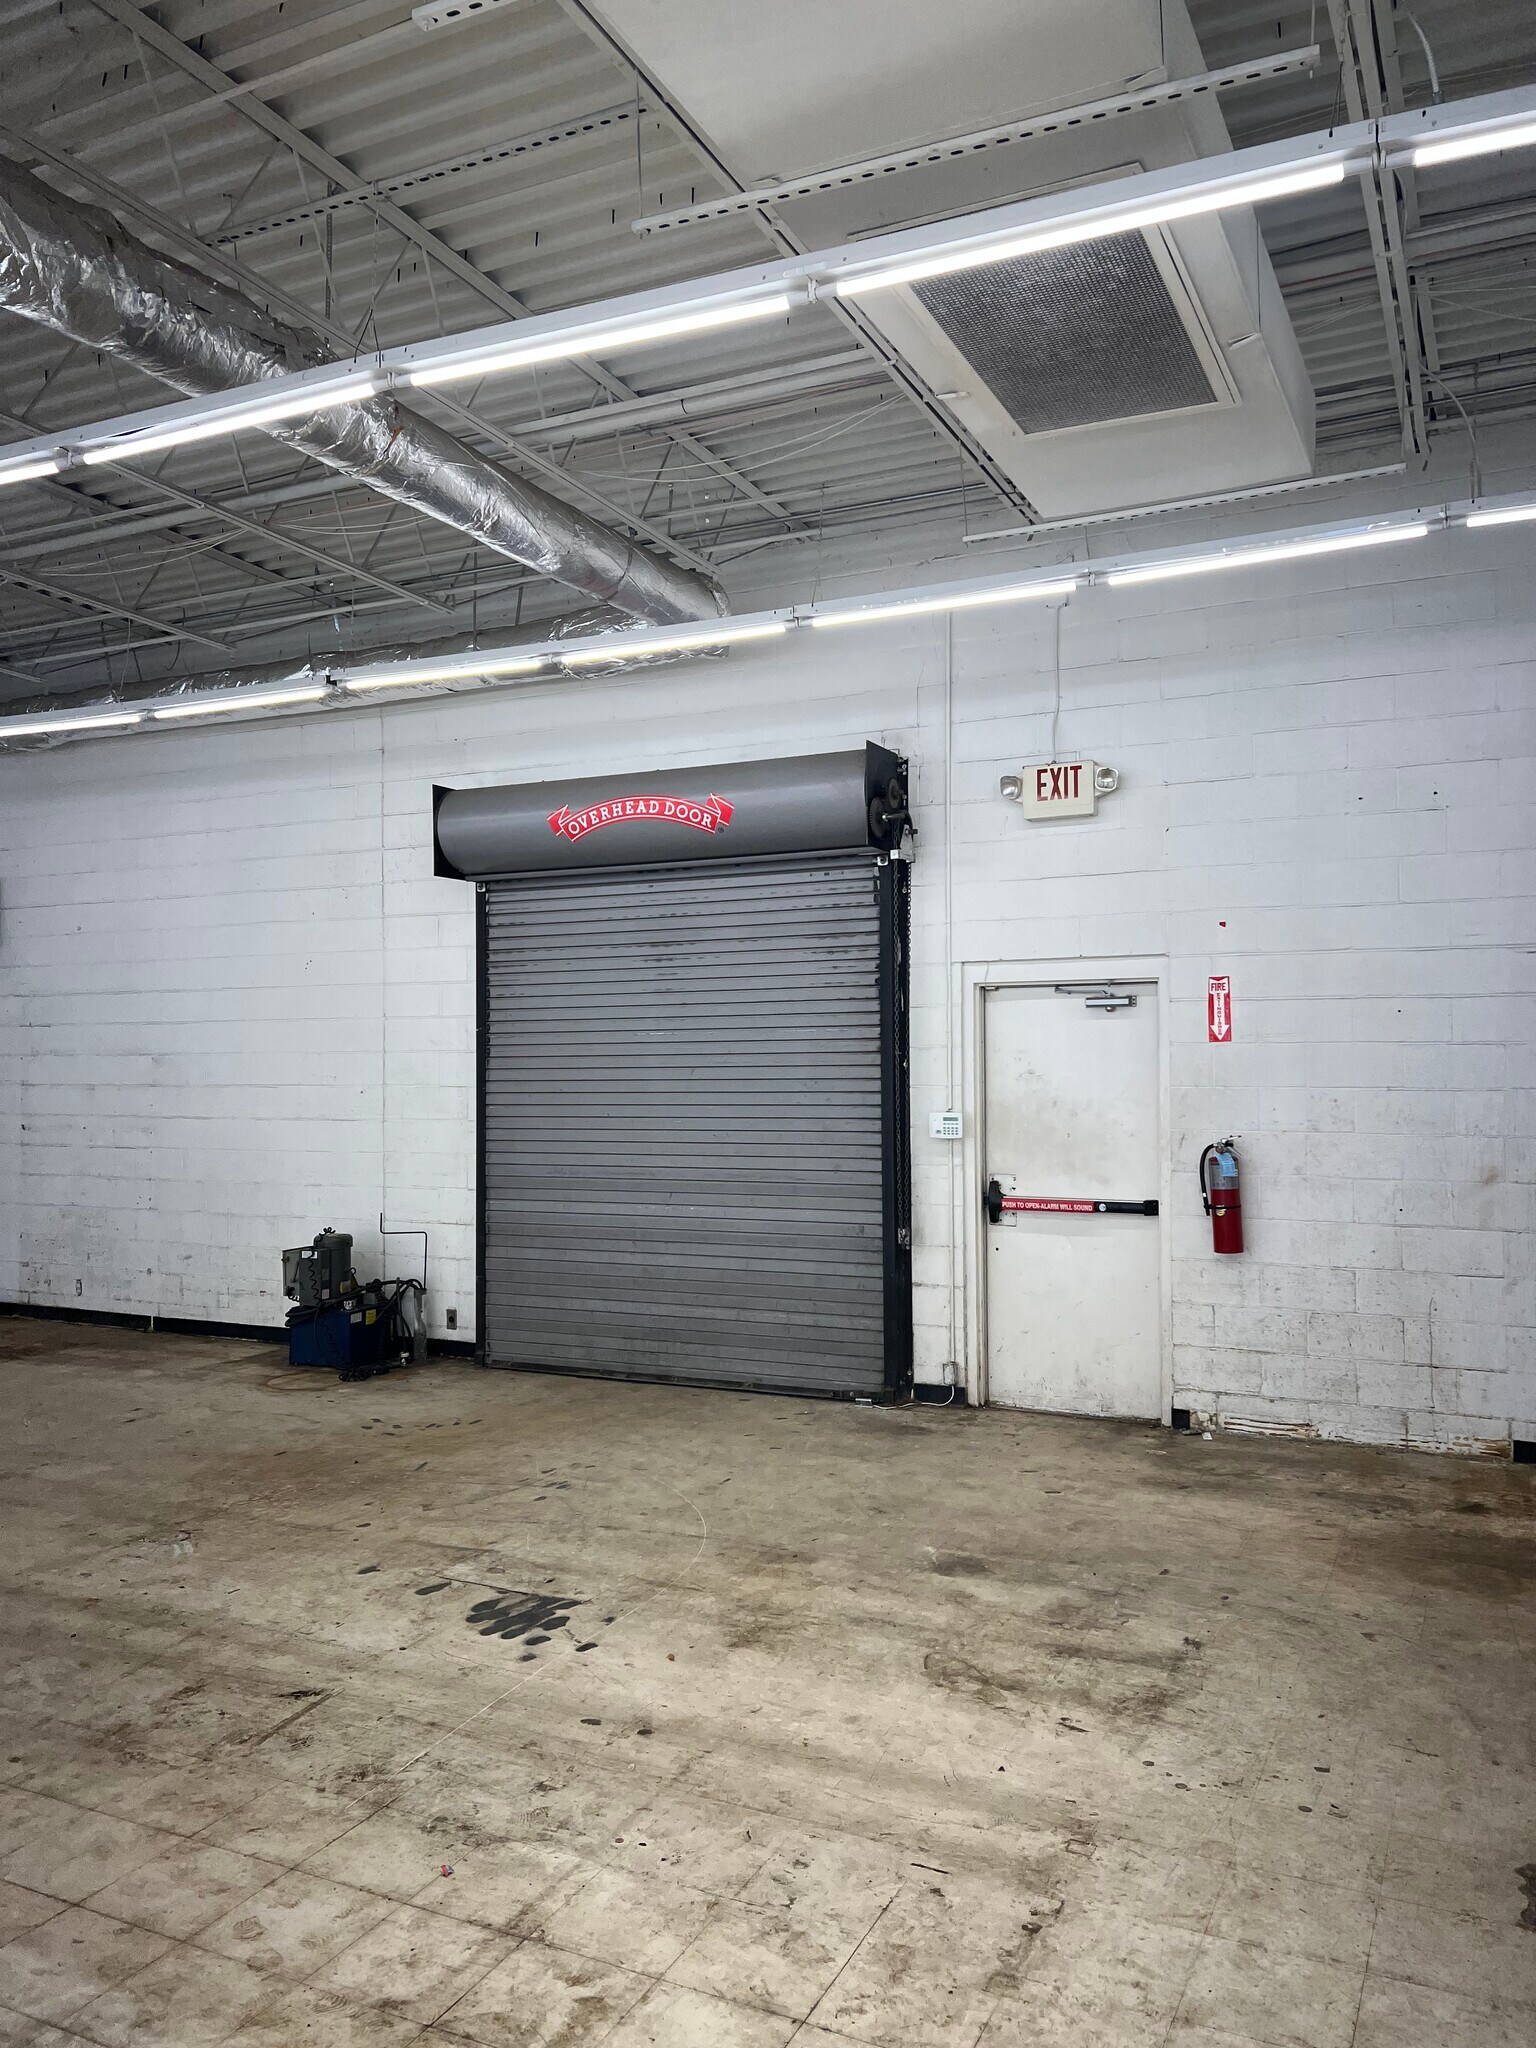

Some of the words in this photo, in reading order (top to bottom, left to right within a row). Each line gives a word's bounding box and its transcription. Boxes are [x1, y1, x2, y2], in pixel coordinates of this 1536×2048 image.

[1036, 765, 1082, 802] EXIT
[568, 800, 660, 835] OVERHEAD
[663, 801, 712, 828] DOOR
[1210, 982, 1226, 992] FIRE
[1060, 1203, 1072, 1211] WILL
